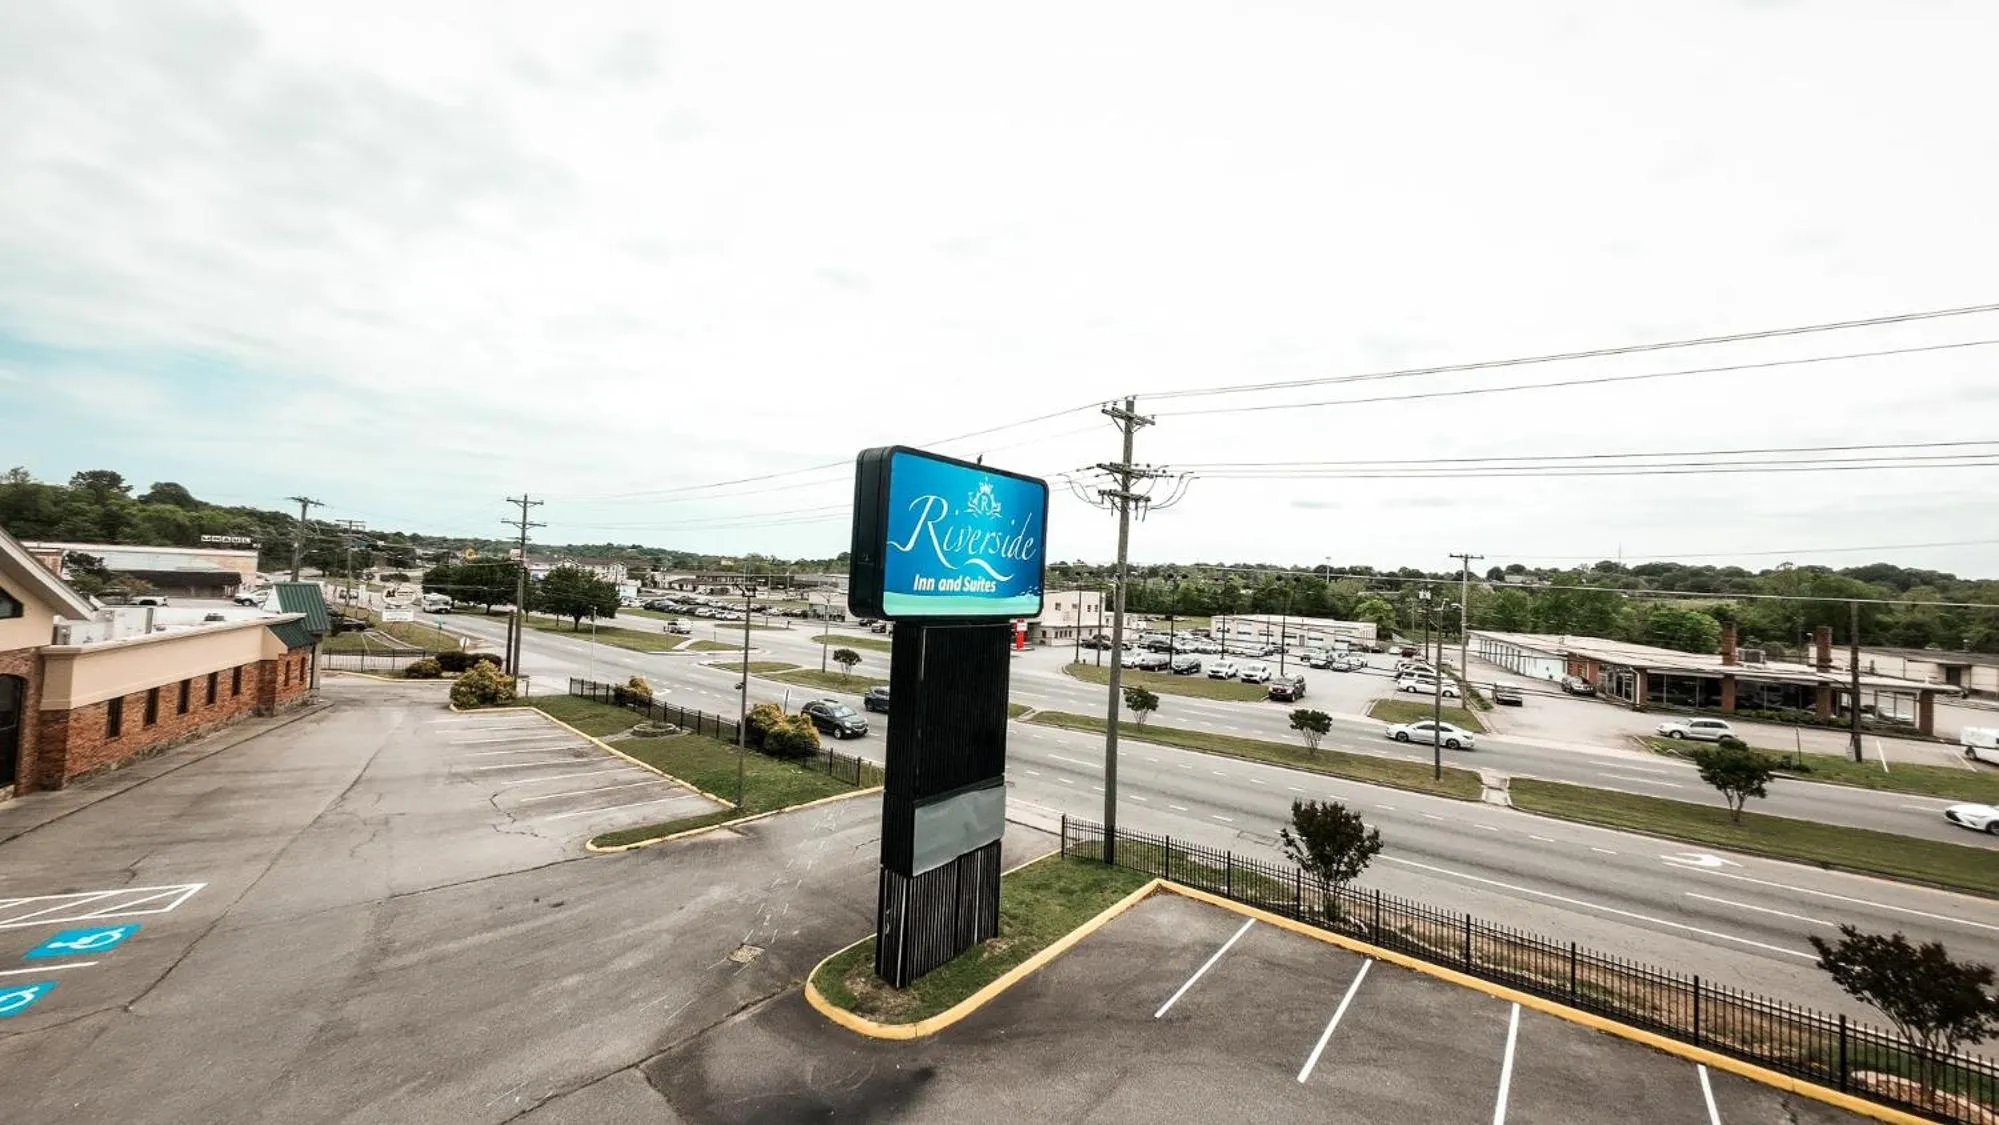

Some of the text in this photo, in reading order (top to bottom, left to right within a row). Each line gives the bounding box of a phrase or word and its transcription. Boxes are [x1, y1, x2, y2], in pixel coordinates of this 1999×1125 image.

[887, 495, 1037, 570] Riverside
[913, 574, 997, 593] Inn and Suites
